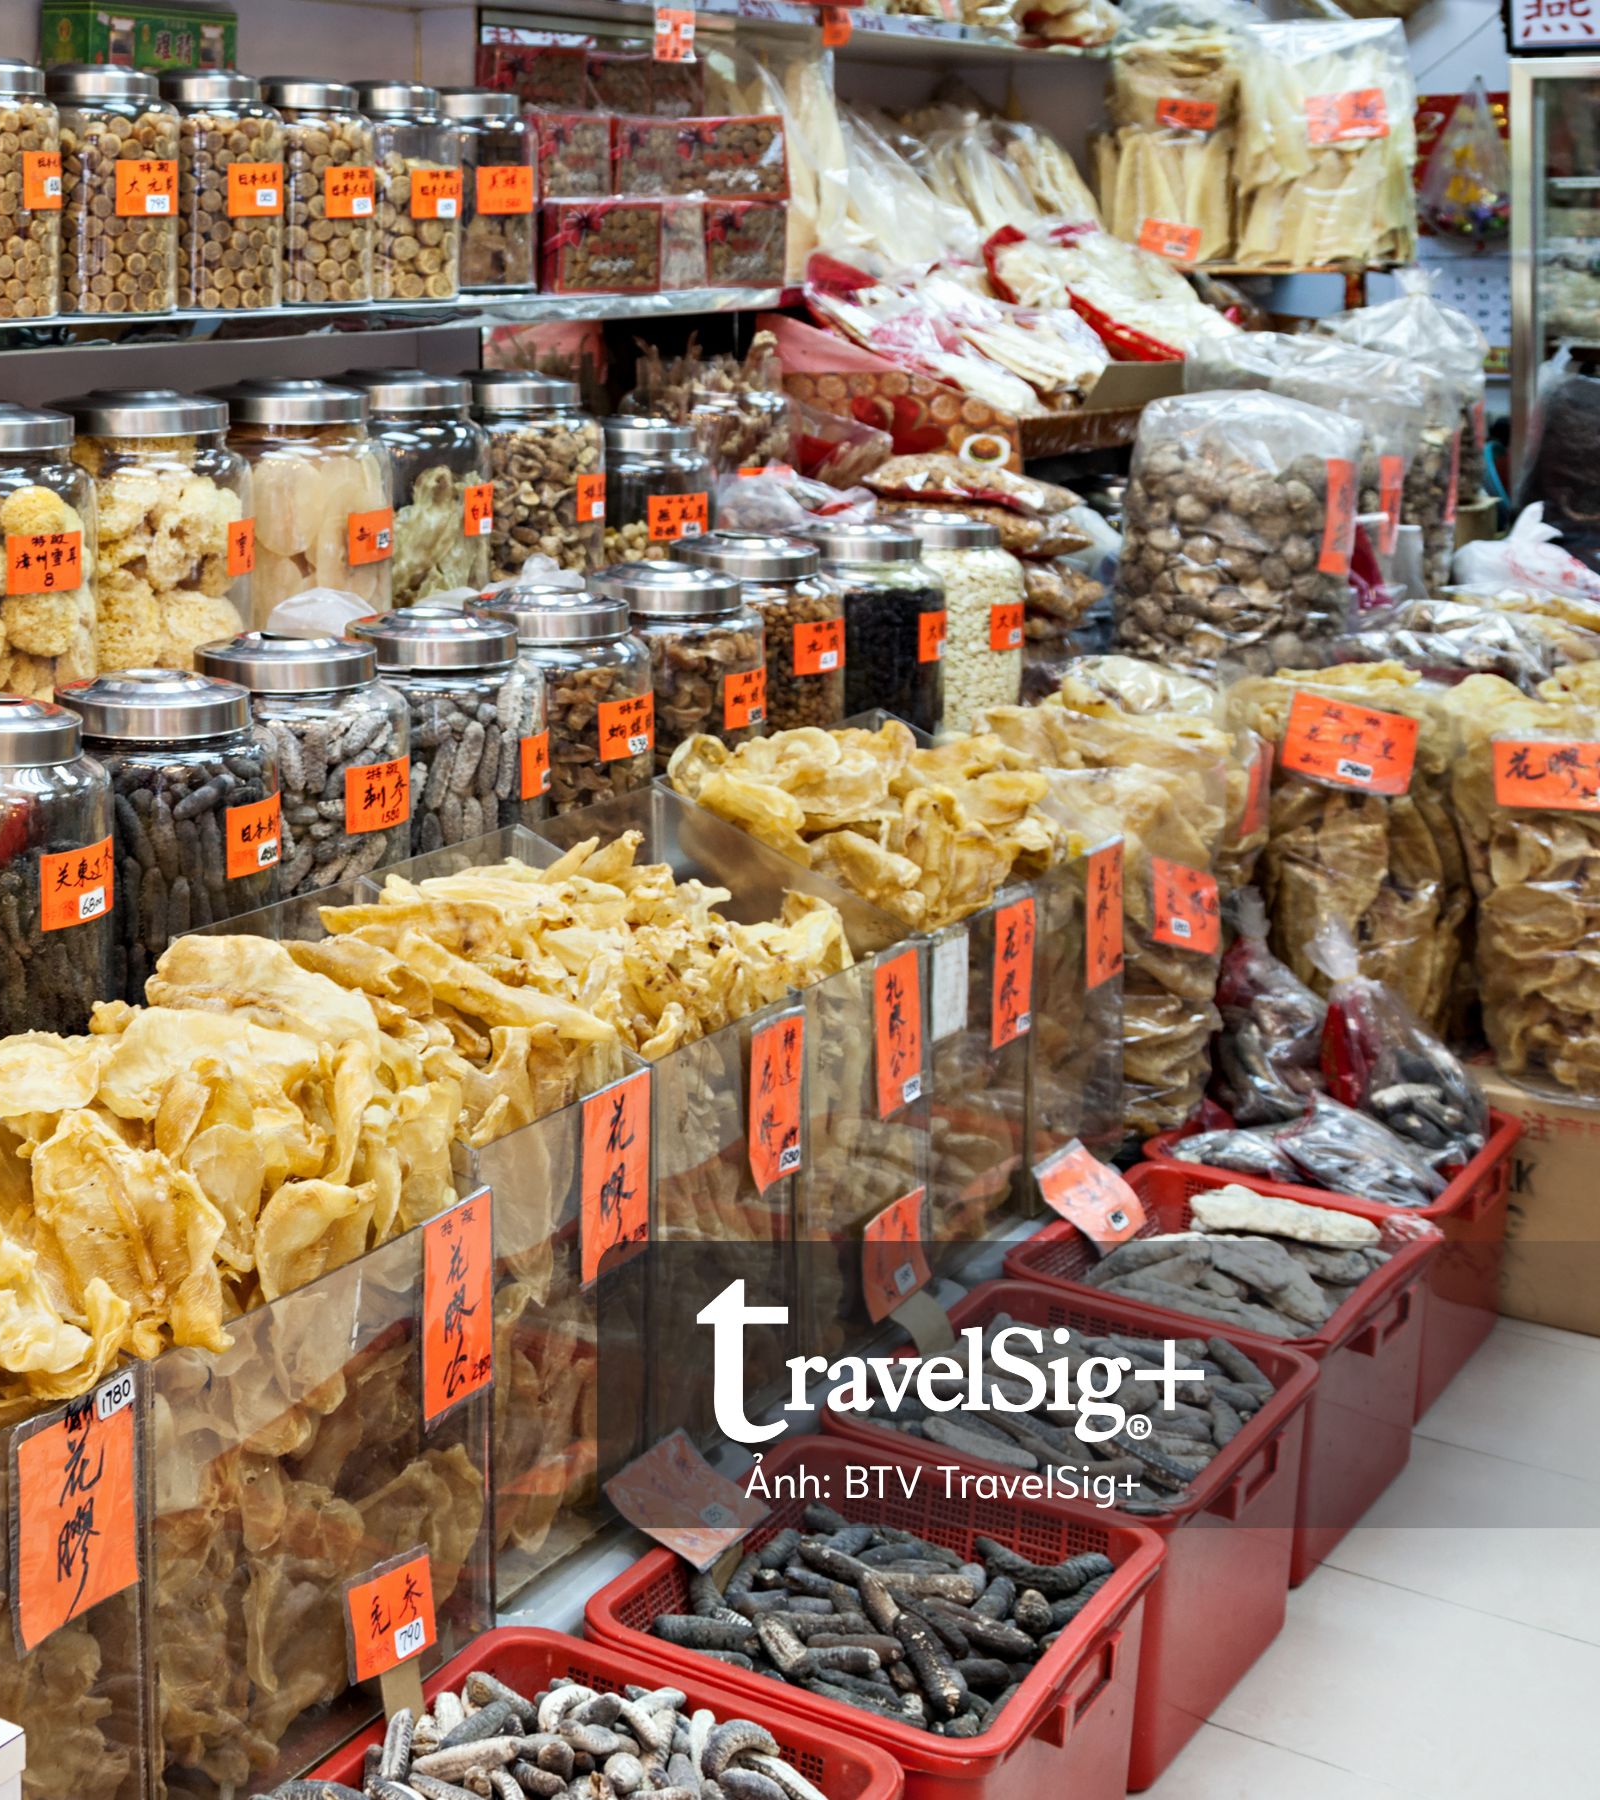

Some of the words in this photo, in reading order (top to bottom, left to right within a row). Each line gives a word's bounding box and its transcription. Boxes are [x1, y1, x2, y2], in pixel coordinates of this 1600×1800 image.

[44, 571, 55, 588] 8
[1505, 747, 1600, 797] 花膠
[101, 1378, 132, 1414] 1780
[399, 1620, 422, 1652] 790
